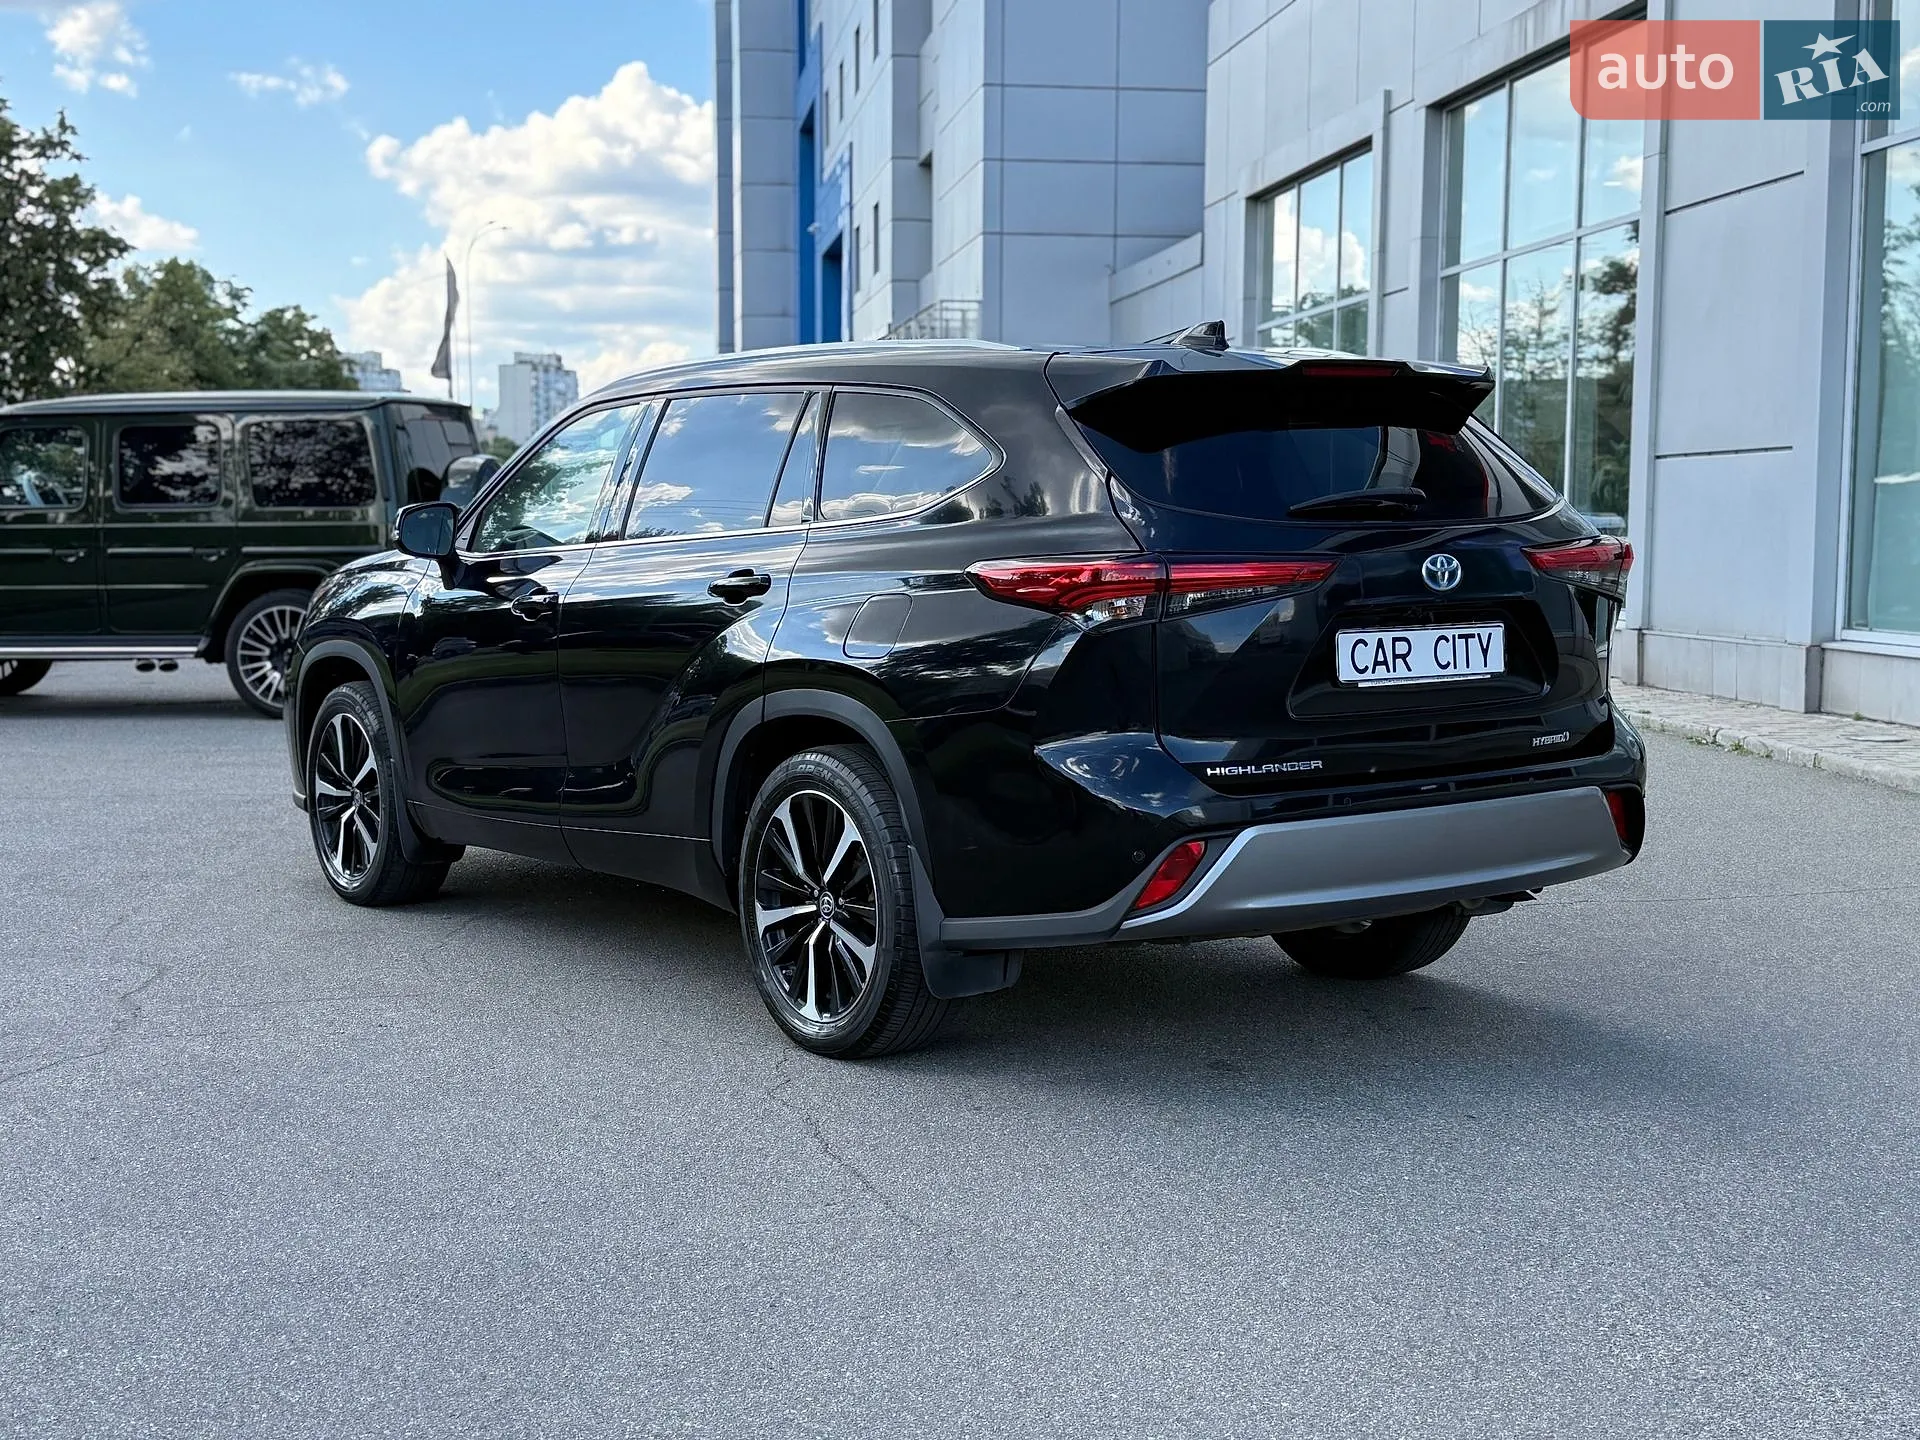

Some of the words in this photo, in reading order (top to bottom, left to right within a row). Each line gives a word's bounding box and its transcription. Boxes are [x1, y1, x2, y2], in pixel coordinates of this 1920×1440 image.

[1351, 637, 1412, 675] CAR
[1433, 632, 1493, 670] CITY
[1532, 734, 1566, 747] HYBRID
[1206, 760, 1323, 777] HIGHLANDER
